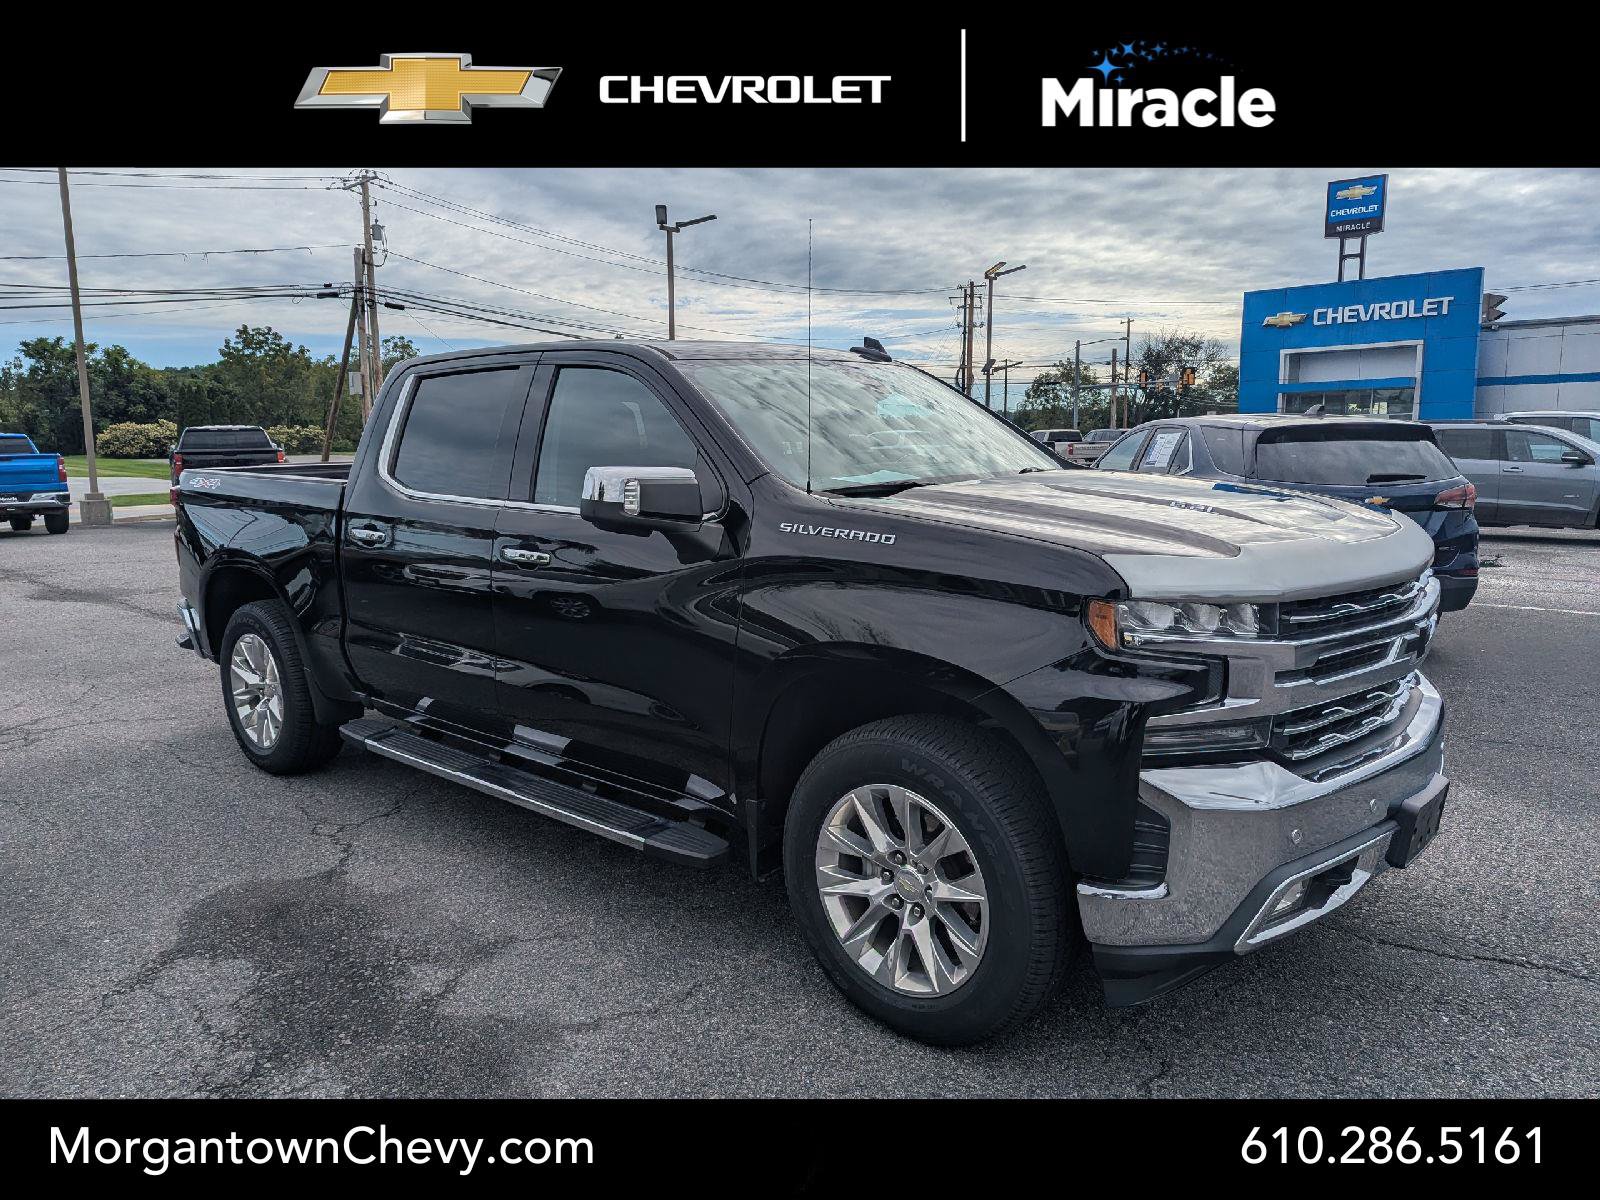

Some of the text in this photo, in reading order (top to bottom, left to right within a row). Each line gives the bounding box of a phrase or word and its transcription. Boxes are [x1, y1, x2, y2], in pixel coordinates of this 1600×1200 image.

[1330, 204, 1379, 217] CHEVROLET
[1336, 221, 1371, 232] MIRACLE
[1313, 296, 1455, 326] CHEVROLET
[779, 522, 896, 545] SILVERADO
